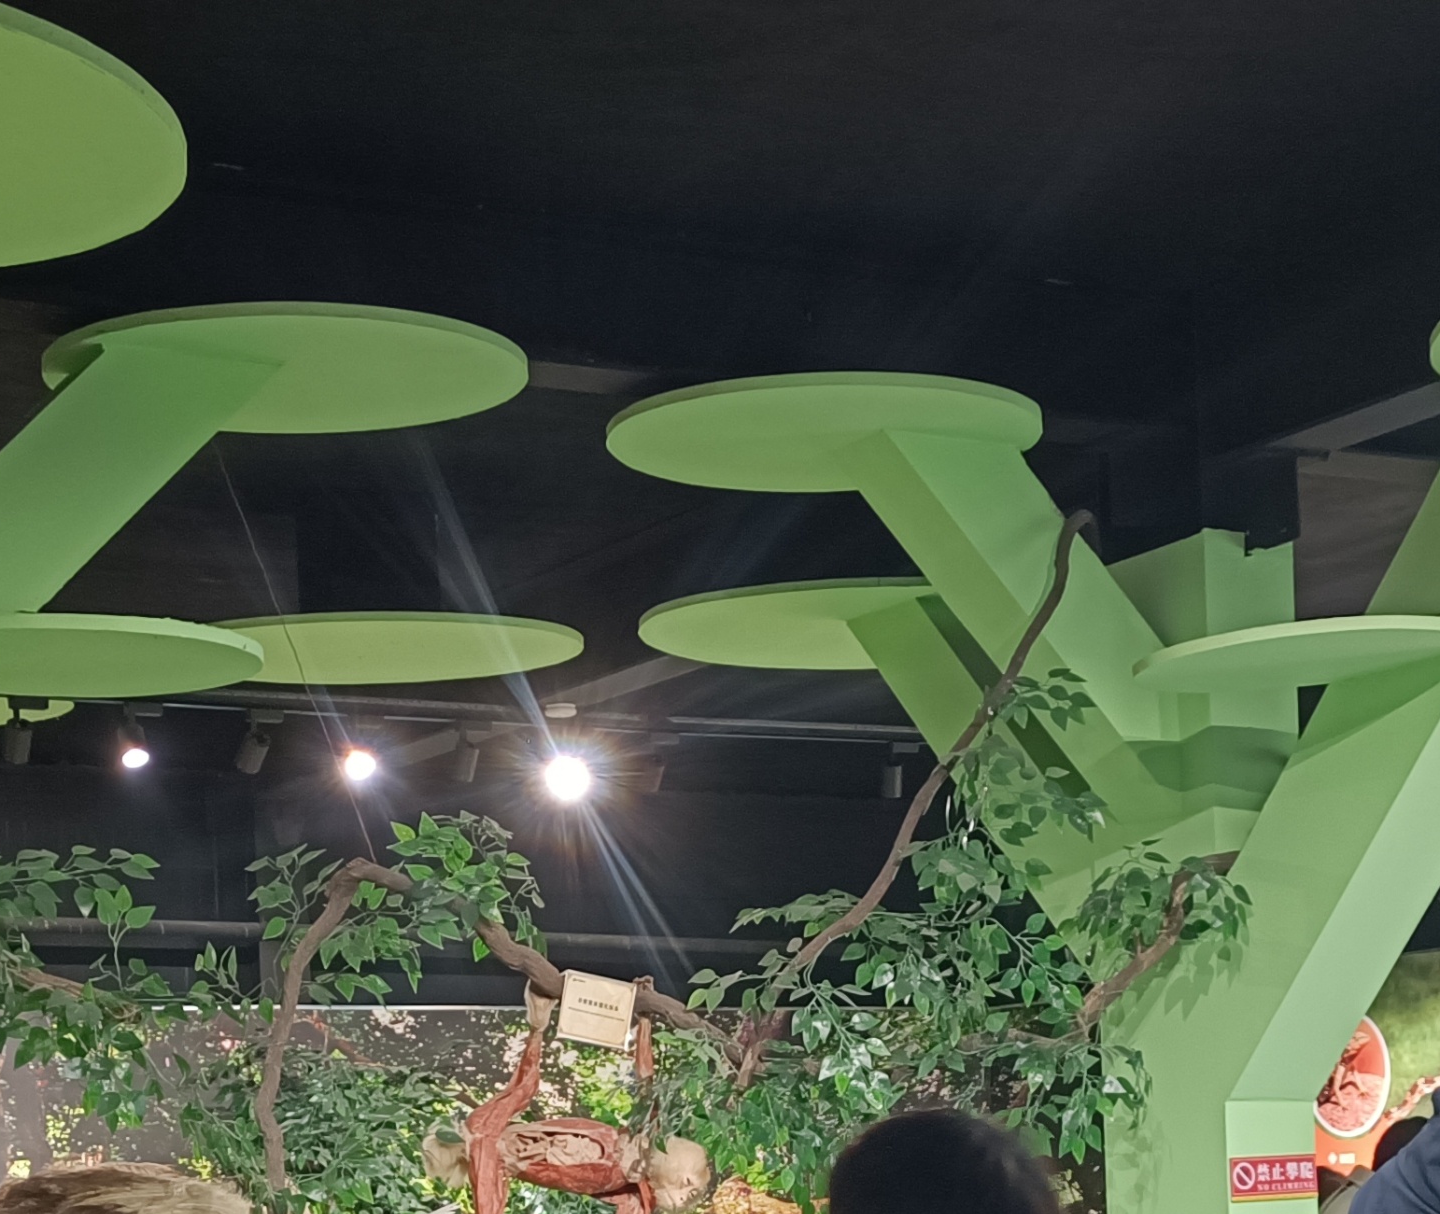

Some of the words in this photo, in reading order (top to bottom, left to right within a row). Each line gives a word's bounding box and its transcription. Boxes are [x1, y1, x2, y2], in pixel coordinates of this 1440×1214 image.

[1256, 1161, 1314, 1181] 禁止攀爬
[1257, 1183, 1270, 1191] NO
